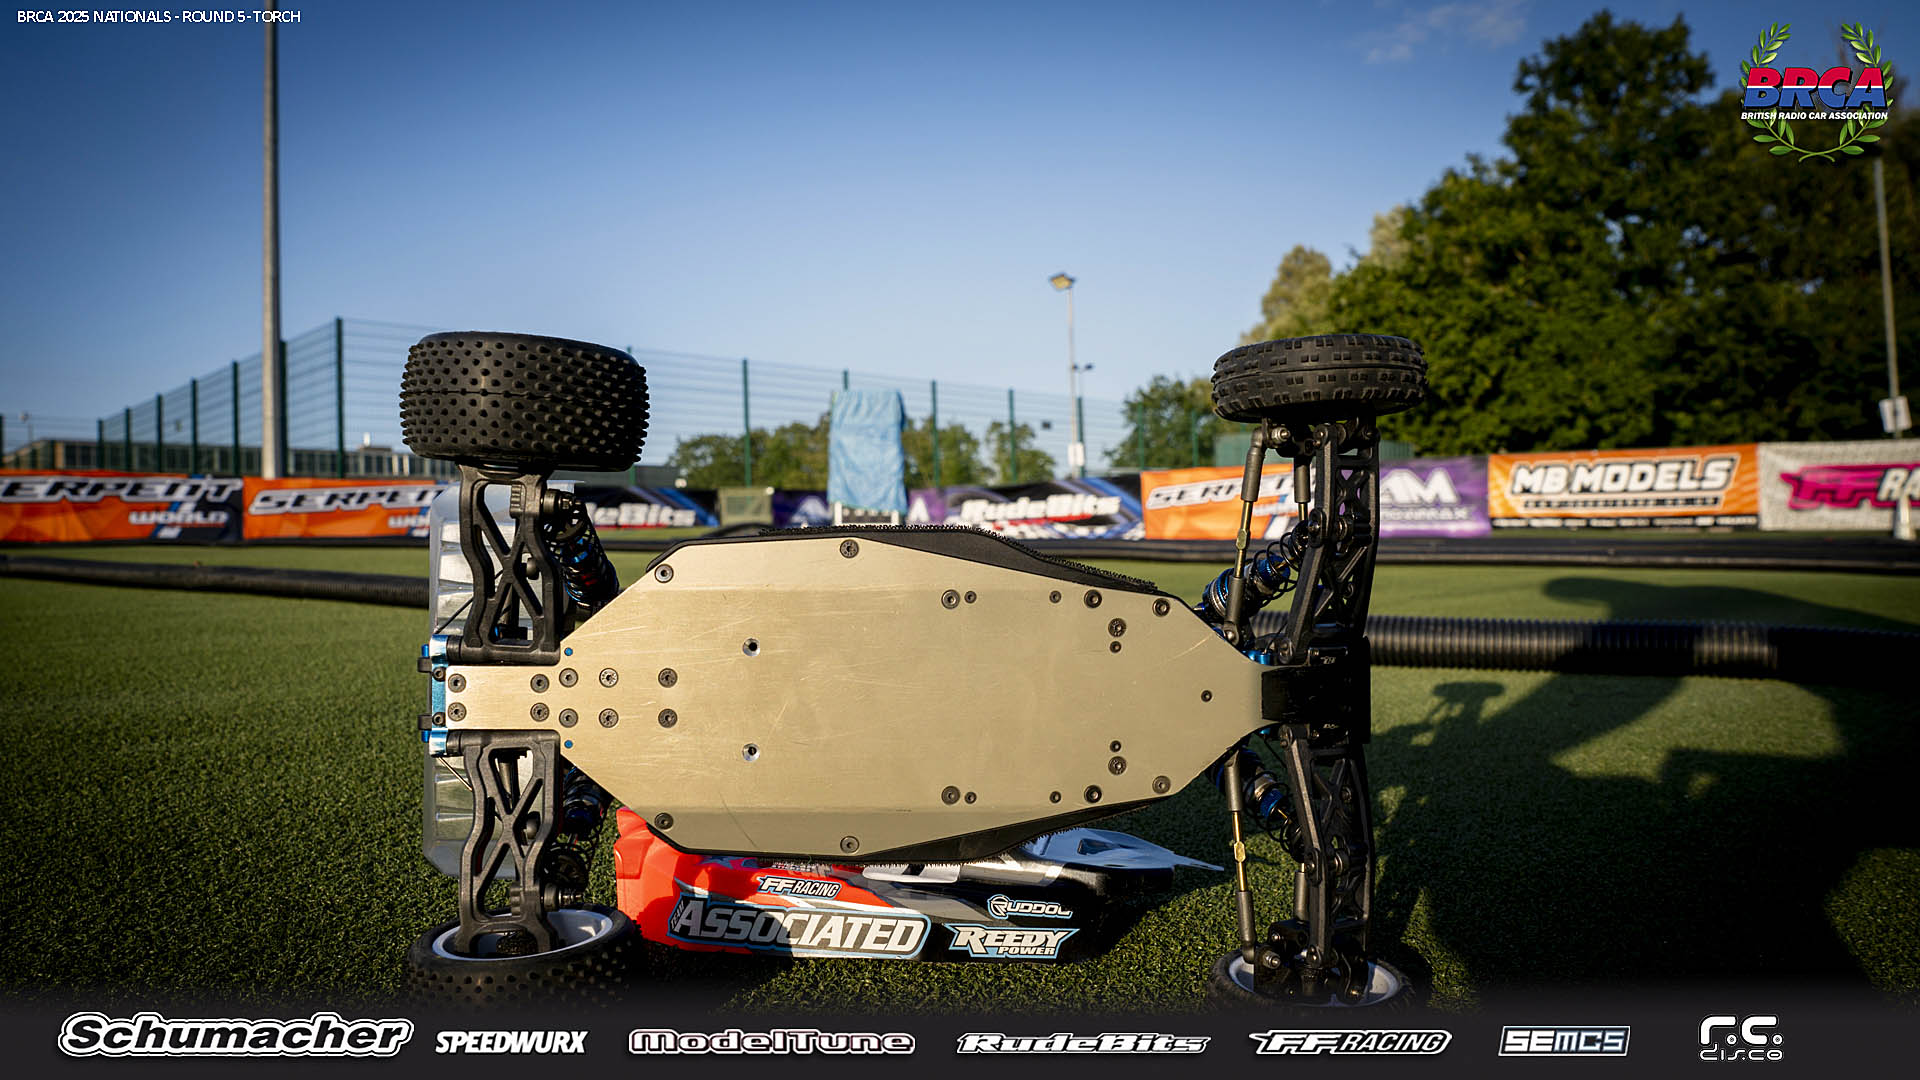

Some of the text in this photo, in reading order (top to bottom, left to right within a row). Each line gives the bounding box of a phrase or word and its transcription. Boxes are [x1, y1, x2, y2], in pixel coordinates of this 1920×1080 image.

[1510, 455, 1739, 495] MB MODELS
[0, 476, 243, 502] ERPENT
[760, 876, 841, 898] FF RACING
[673, 900, 926, 953] ASSOCIATED
[953, 926, 1069, 954] REEDY
[998, 947, 1055, 955] POWER
